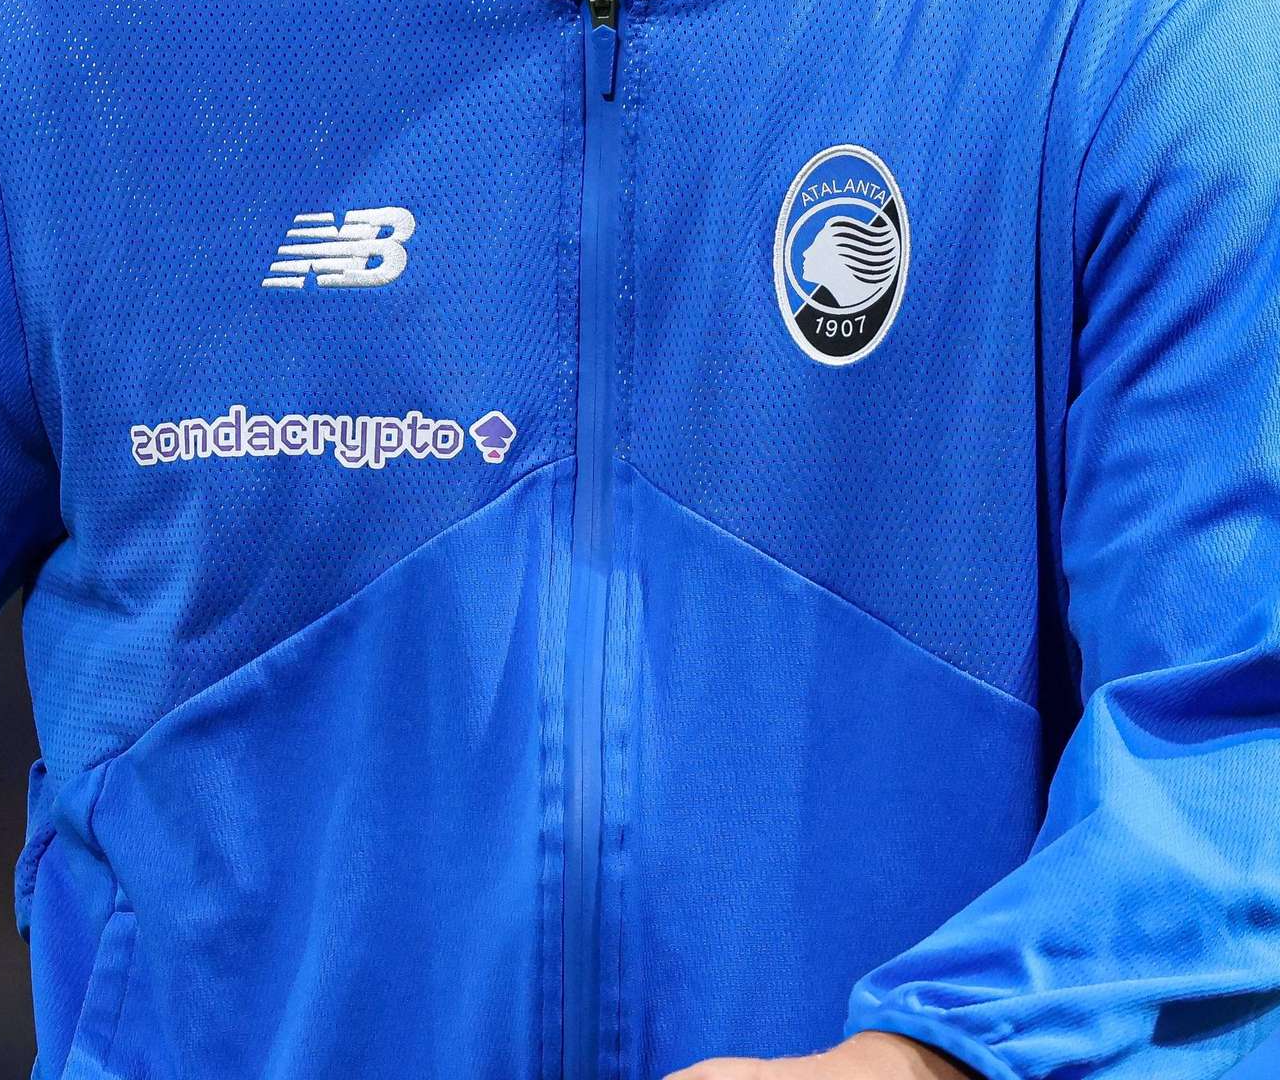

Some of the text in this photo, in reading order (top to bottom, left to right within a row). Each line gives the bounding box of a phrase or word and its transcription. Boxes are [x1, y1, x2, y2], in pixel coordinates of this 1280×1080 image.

[802, 178, 886, 207] ATALANTA
[261, 206, 416, 288] NB
[815, 314, 867, 337] 1907
[131, 404, 464, 469] zondacrypto
